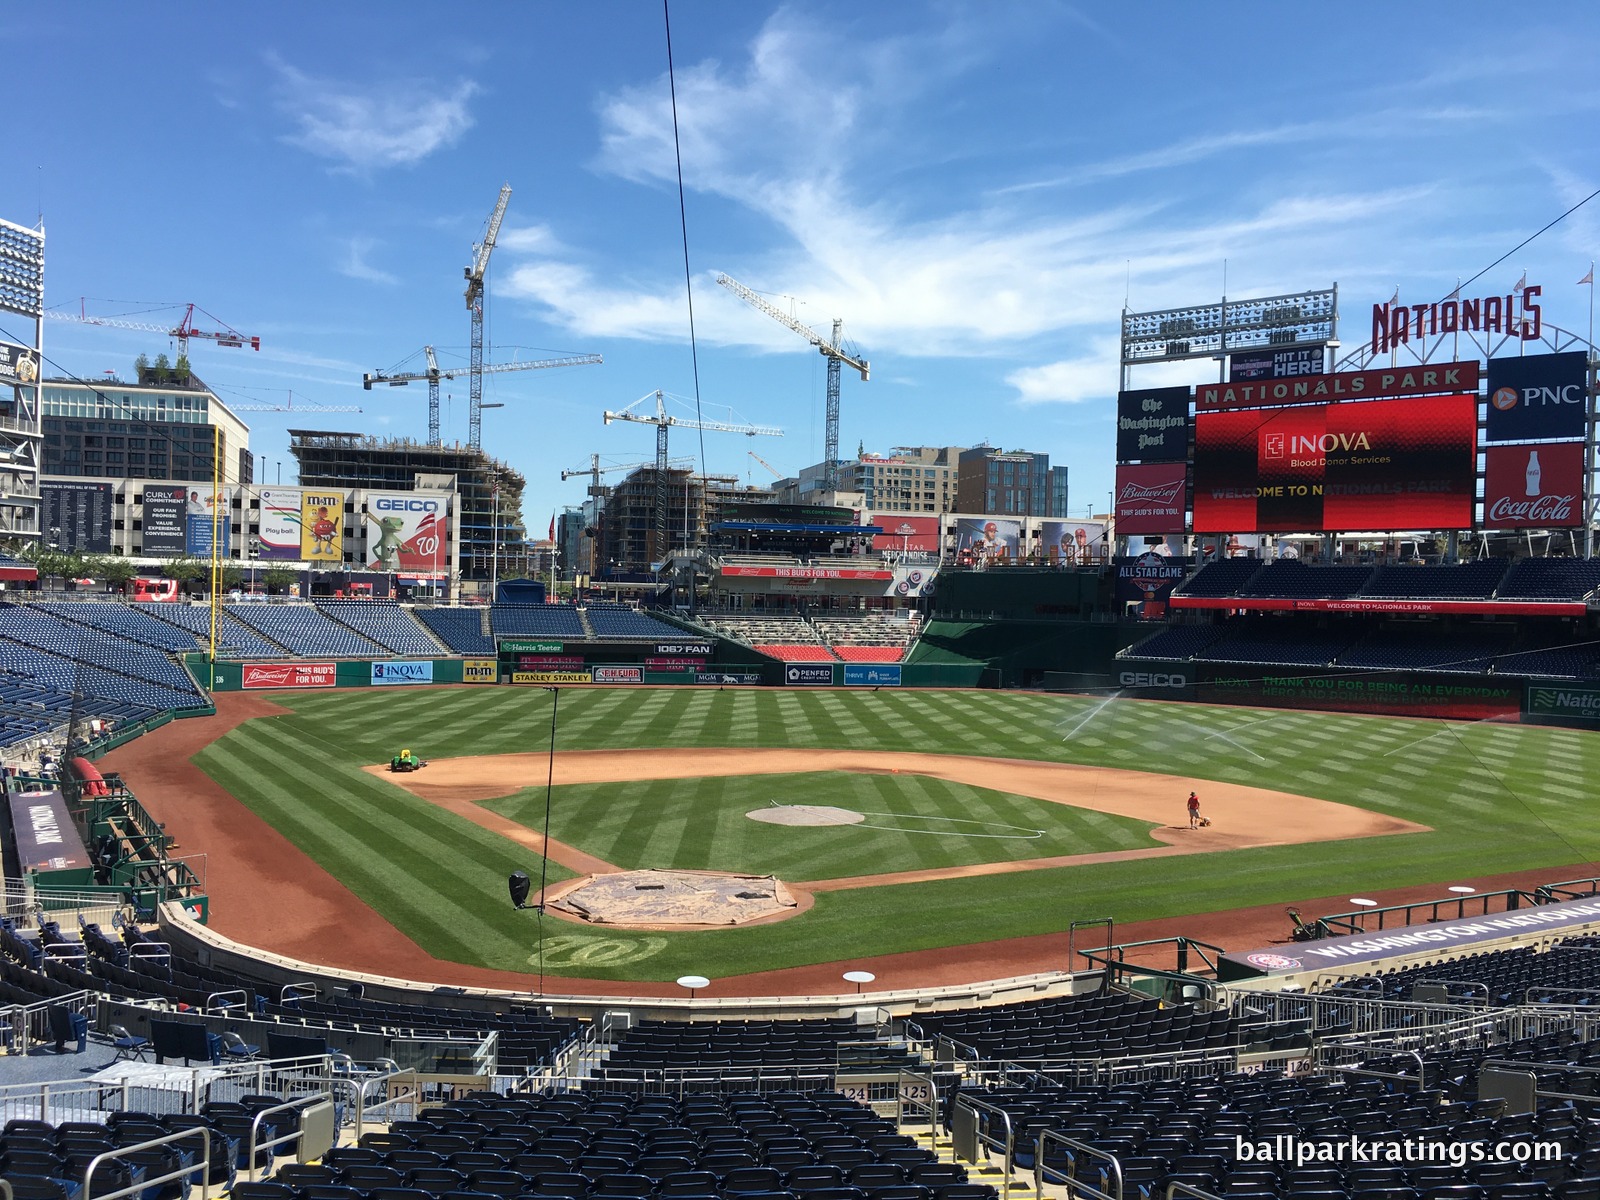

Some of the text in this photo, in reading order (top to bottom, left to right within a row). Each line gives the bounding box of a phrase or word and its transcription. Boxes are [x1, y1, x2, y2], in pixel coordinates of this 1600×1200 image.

[1372, 286, 1542, 354] NATIONALS
[1274, 350, 1310, 362] HIT IT
[1274, 360, 1322, 376] HERE
[1205, 369, 1462, 404] NATIONALS PARK
[1522, 384, 1580, 406] PNC
[1142, 398, 1162, 412] The
[1120, 415, 1186, 430] Washington
[1138, 433, 1164, 450] Post
[1292, 432, 1370, 454] INOVA
[1291, 456, 1391, 468] Blood Donor Services
[1122, 486, 1177, 498] Budweiser
[1212, 480, 1450, 499] WELCOME TO NATIONALS PARK
[376, 499, 438, 512] GEICO
[1490, 495, 1576, 521] Coca-Cola
[1120, 568, 1182, 577] ALL STAR GAME
[251, 672, 288, 680] Budweiser
[387, 666, 423, 676] INOVA
[1120, 672, 1186, 688] GEICO
[1215, 677, 1250, 688] INOVA
[1263, 688, 1295, 697] HERO
[1301, 689, 1325, 698] AND
[1264, 677, 1510, 698] THANK YOU FOR BEING AN EVERYDAY
[1305, 922, 1492, 958] WASHINGTON
[1291, 1060, 1310, 1073] 126
[903, 1086, 928, 1098] 125
